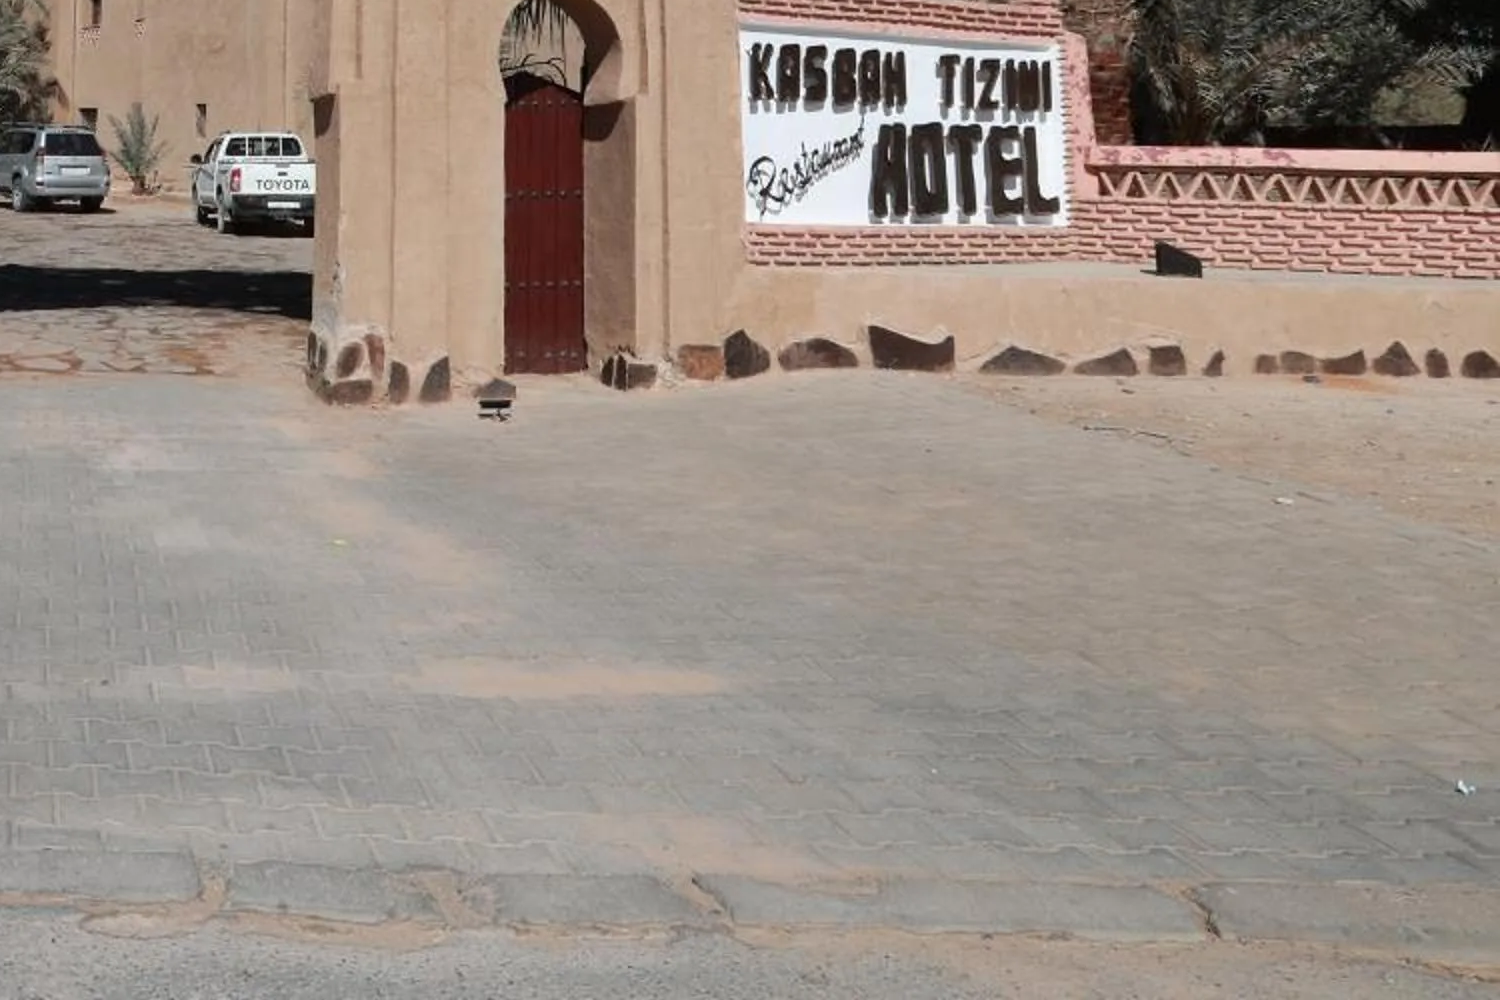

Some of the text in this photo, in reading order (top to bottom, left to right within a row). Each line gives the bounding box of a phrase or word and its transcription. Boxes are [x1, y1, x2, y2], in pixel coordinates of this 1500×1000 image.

[749, 43, 908, 109] KASBAH
[255, 179, 310, 191] TOYOTA
[749, 112, 865, 219] Restaurant
[870, 121, 1061, 218] HOTEL
